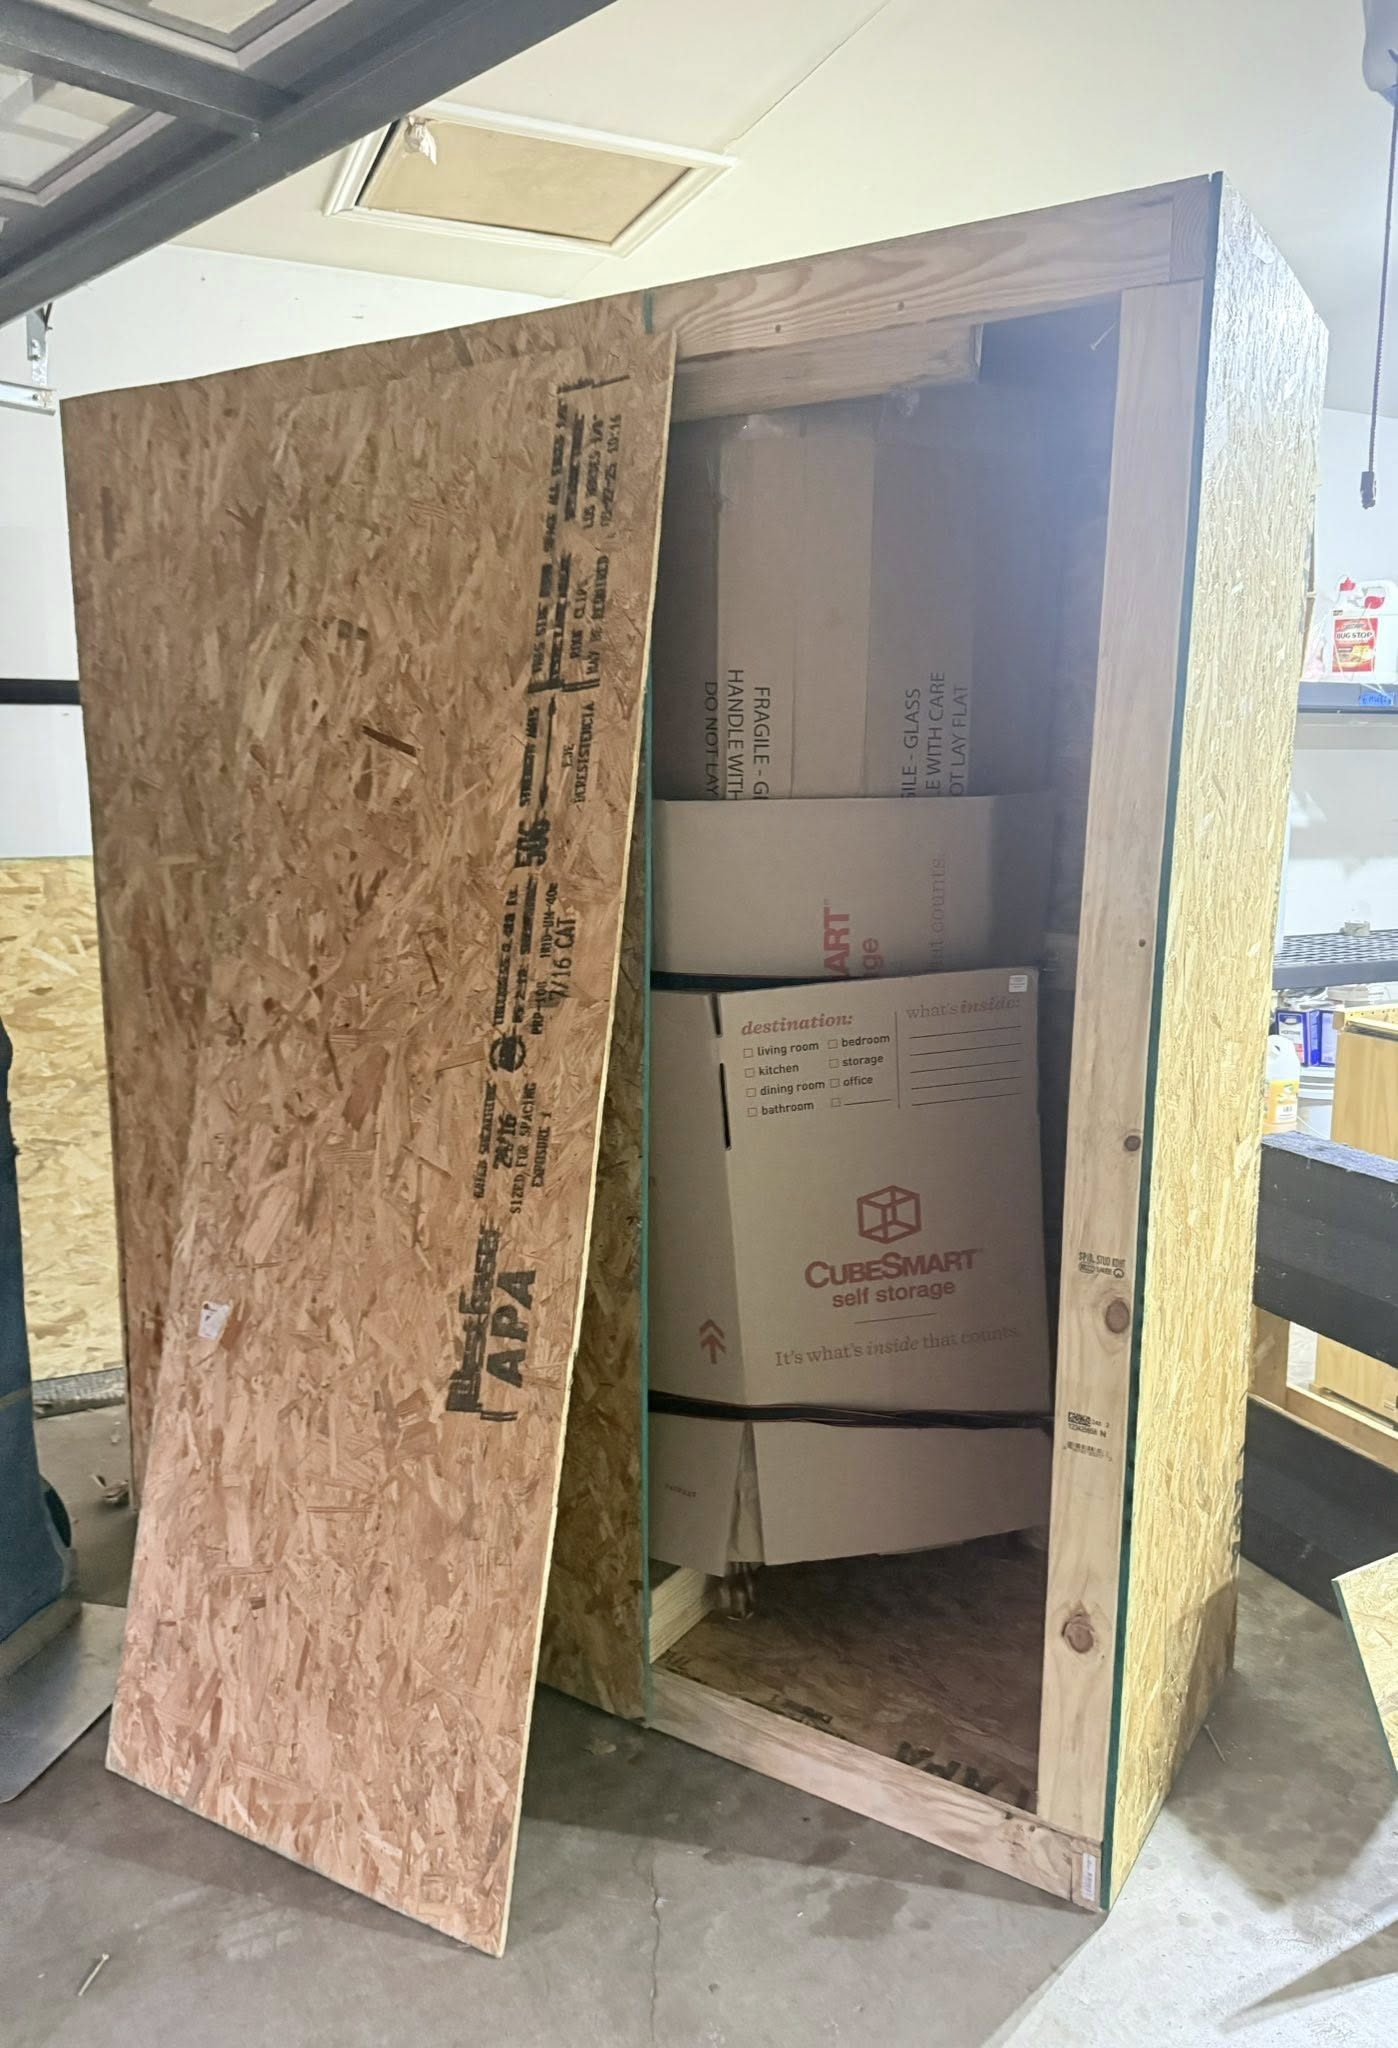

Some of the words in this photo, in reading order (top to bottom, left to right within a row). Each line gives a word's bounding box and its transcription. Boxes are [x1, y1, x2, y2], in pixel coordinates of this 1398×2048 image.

[704, 682, 719, 711] DO
[727, 669, 744, 750] HANDLE
[928, 672, 945, 721] CARE
[952, 684, 969, 727] FLAT
[753, 687, 771, 765] FRAGILE
[903, 688, 921, 748] GLASS
[705, 717, 719, 758] NOT
[926, 727, 943, 775] WITH
[951, 734, 967, 766] LAY
[706, 763, 720, 796] LAY
[555, 916, 576, 949] CAT
[549, 956, 572, 1001] 7/16
[741, 1013, 854, 1036] destination:
[906, 1003, 959, 1019] what's
[757, 1045, 788, 1057] living
[790, 1042, 820, 1053] room
[841, 1034, 891, 1048] bedroom
[758, 1064, 800, 1076] kitchen
[842, 1054, 885, 1067] storage
[760, 1084, 794, 1096] dining
[796, 1080, 826, 1092] room
[843, 1075, 874, 1087] office
[519, 1081, 537, 1137] SPACING
[761, 1102, 815, 1116] bathroom
[516, 1143, 530, 1167] FOR
[532, 1124, 550, 1188] EXPOSURE
[510, 1172, 526, 1214] SIZED
[832, 1287, 870, 1308] self
[875, 1280, 956, 1303] storage
[485, 1265, 535, 1388] APA
[775, 1351, 804, 1367] It's
[806, 1343, 864, 1364] what's
[866, 1335, 919, 1356] inside
[922, 1330, 957, 1349] that
